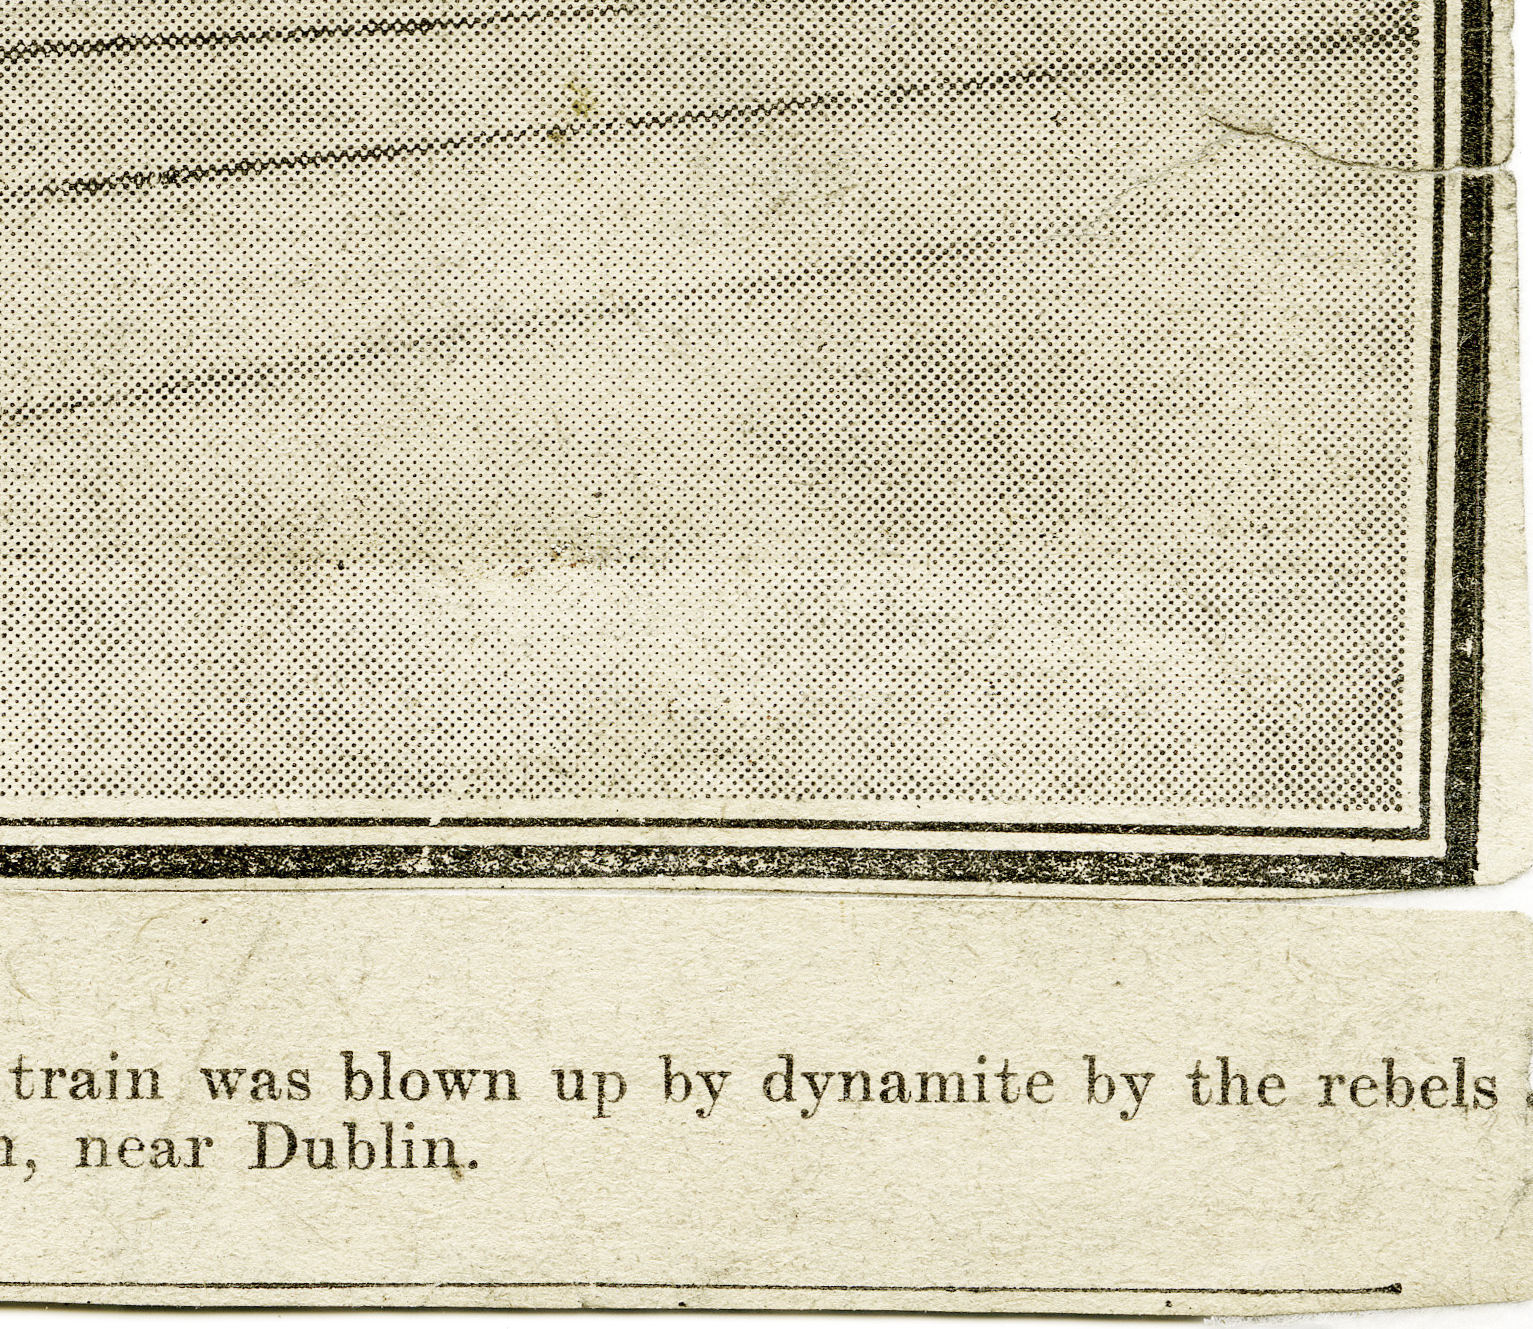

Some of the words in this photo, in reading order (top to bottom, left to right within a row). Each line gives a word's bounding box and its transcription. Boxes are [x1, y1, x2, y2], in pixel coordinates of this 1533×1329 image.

[9, 1051, 163, 1101] train
[200, 1065, 311, 1101] was
[340, 1049, 520, 1103] blown
[551, 1067, 628, 1119] up
[660, 1054, 733, 1120] by
[762, 1053, 1056, 1120] dynamite
[1083, 1054, 1156, 1121] by
[1186, 1055, 1287, 1107] the
[1316, 1056, 1499, 1110] rebels
[73, 1133, 215, 1170] near
[247, 1120, 479, 1174] Dublin.
